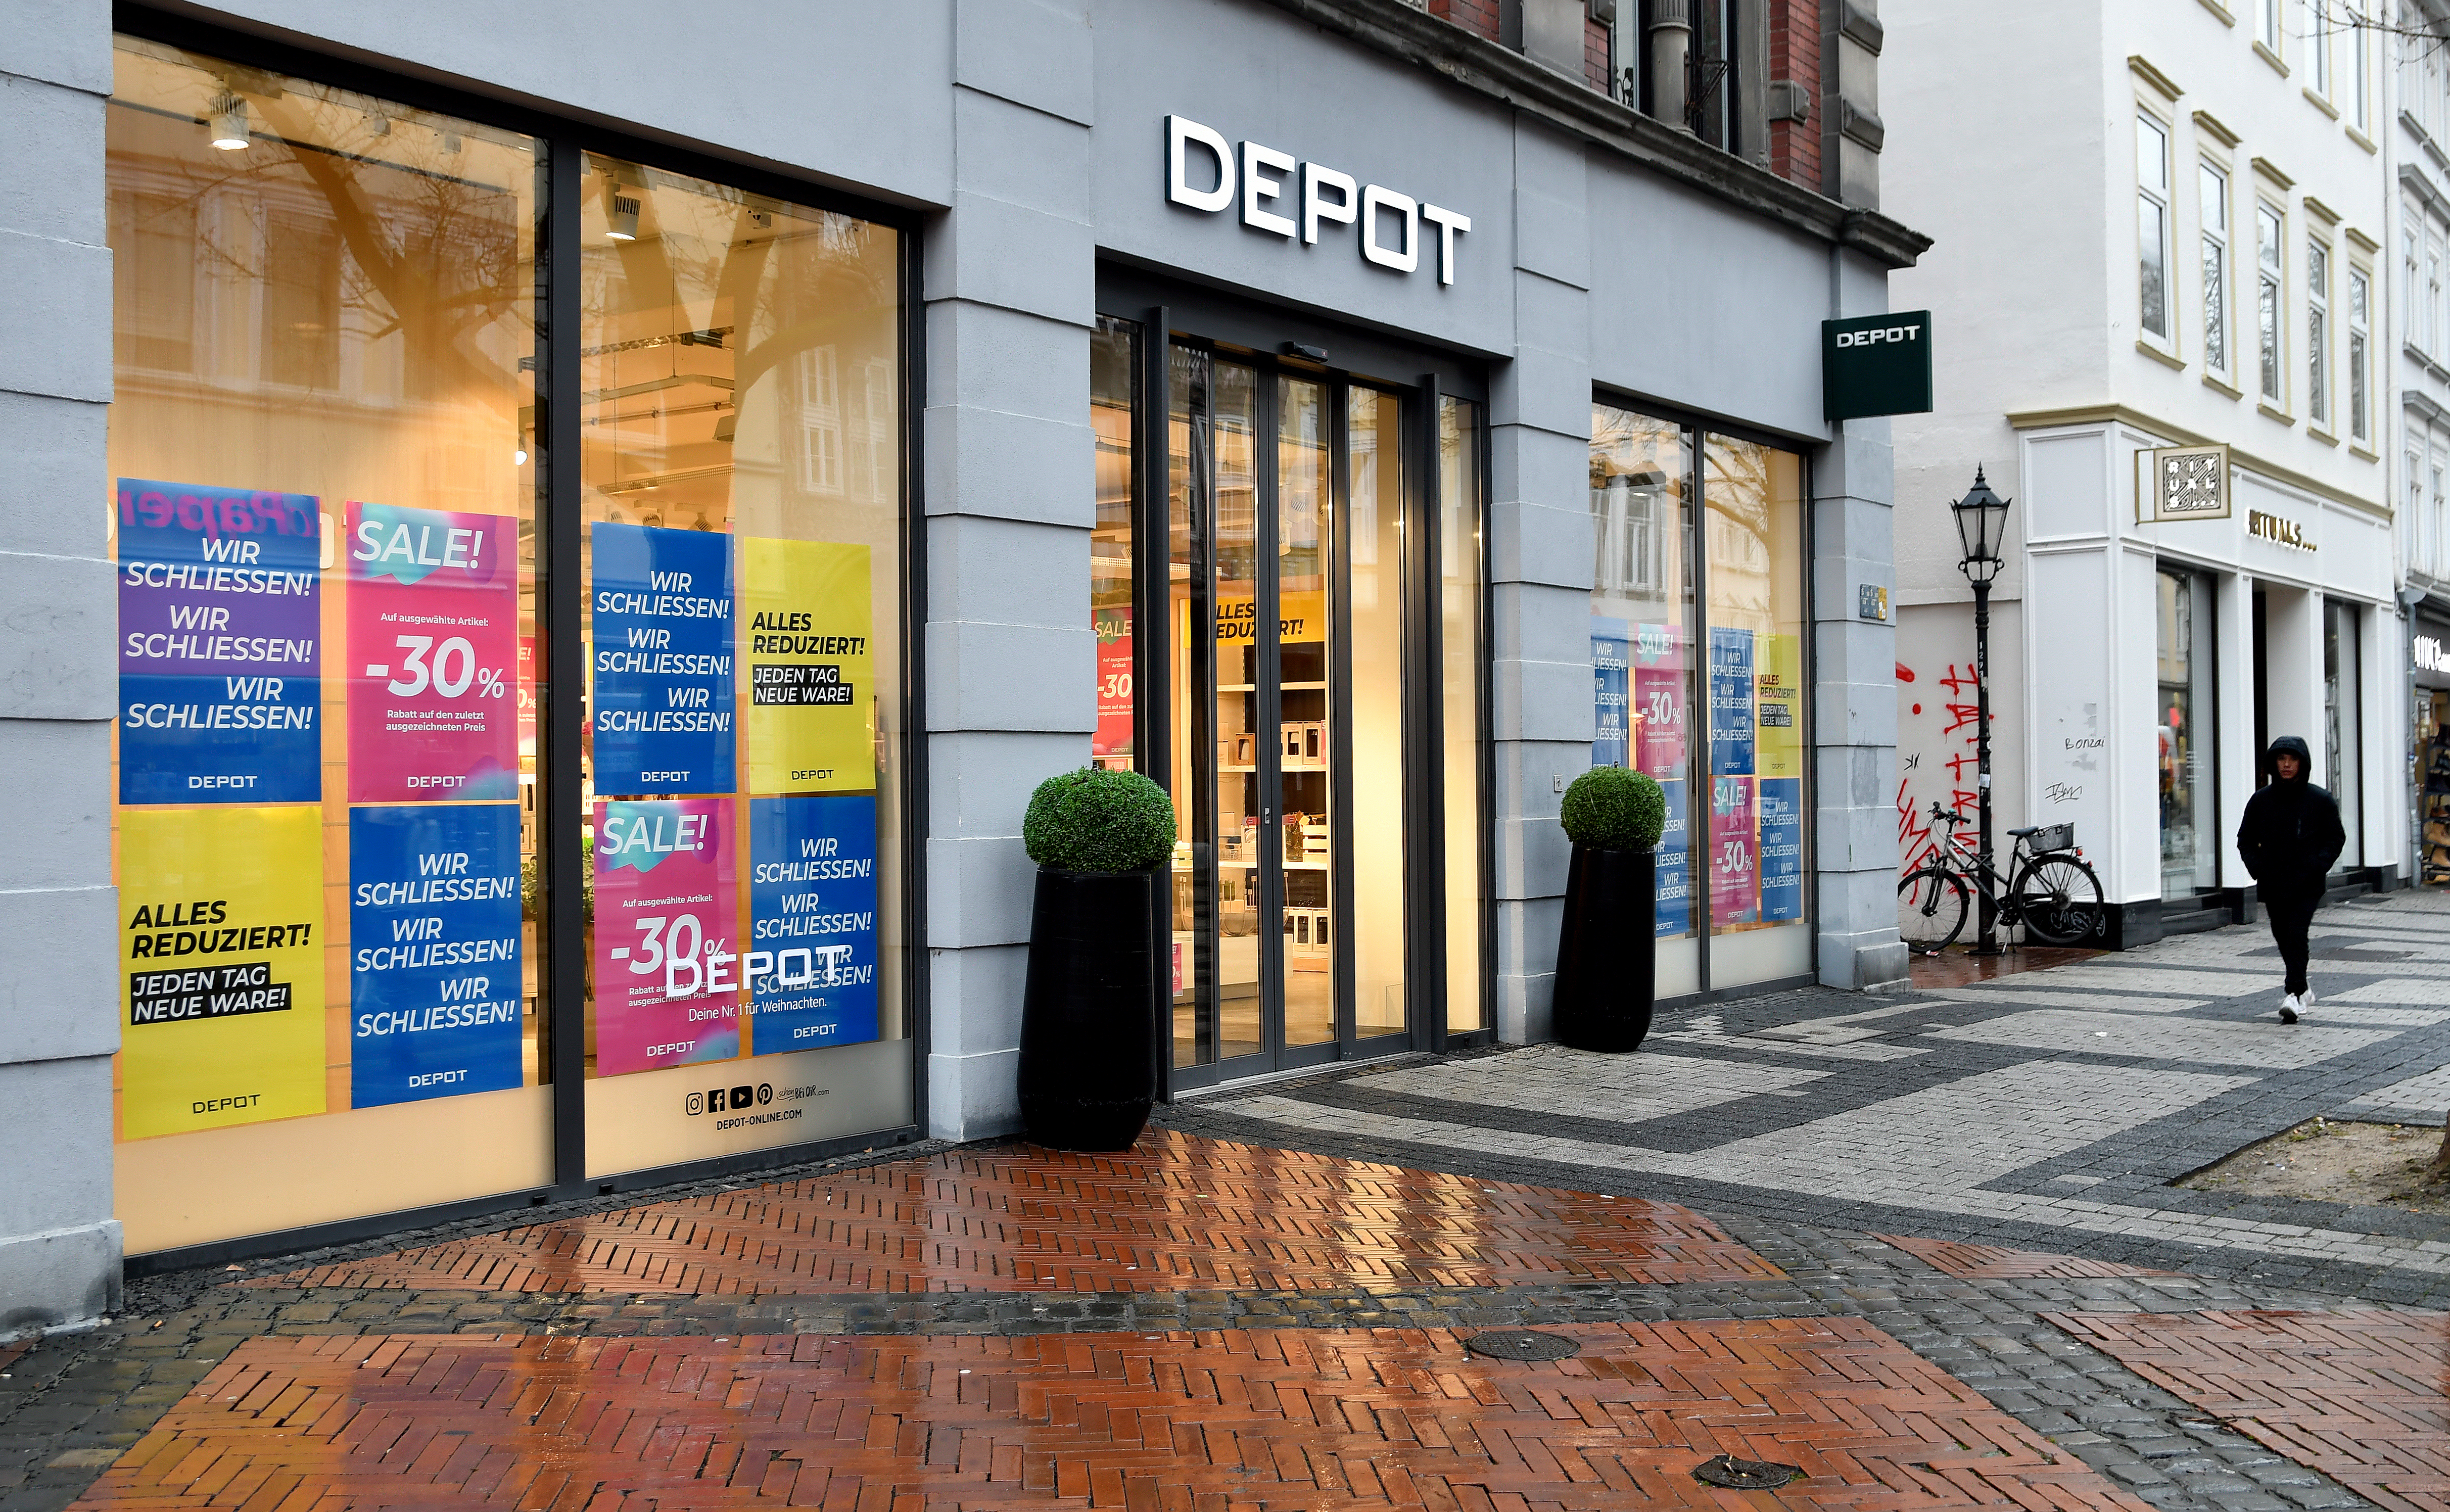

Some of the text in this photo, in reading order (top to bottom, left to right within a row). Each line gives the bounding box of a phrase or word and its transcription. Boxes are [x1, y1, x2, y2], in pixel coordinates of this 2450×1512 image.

[1164, 114, 1472, 286] DEPOT
[1836, 325, 1920, 348] DEPOT
[202, 538, 260, 564] WIR
[353, 521, 484, 569] SALE!
[125, 562, 312, 596] SCHLIESSEN!
[649, 571, 692, 593] WIR
[597, 592, 729, 619] SCHLIESSEN!
[1216, 602, 1254, 619] LLES
[170, 605, 230, 631] WIR
[381, 612, 489, 626] Auf ausgewählte Artikel:
[751, 611, 812, 632] ALLES
[1095, 620, 1132, 637] SALE
[627, 628, 671, 649] WIR
[752, 634, 865, 656] REDUZIERT!
[1637, 633, 1674, 656] SALE!
[125, 633, 313, 664] SCHLIESSEN!
[1596, 642, 1613, 655] WIR
[1727, 652, 1740, 664] WIR
[365, 635, 505, 699] -30%
[597, 651, 730, 676] SCHLIESSEN!
[1590, 657, 1627, 672] LIESSEN!
[1711, 665, 1752, 677] SCHLIESSEN!
[753, 668, 837, 684] JEDEN TAG
[1760, 674, 1779, 685] ALLES
[226, 677, 284, 701] WIR
[754, 687, 851, 703] NEUE WARE!
[1098, 674, 1132, 698] -30
[1721, 683, 1734, 695] WIR
[1760, 687, 1796, 699] REDUZIERT!
[667, 688, 710, 708] WIR
[1594, 691, 1627, 705] LIESSEN!
[1712, 697, 1753, 708] SCHLIESSEN!
[126, 704, 313, 730] SCHLIESSEN!
[387, 710, 485, 719] Rabatt auf den zuletzt
[1641, 691, 1681, 725] -30%
[1761, 705, 1787, 715] JEDEN TAG
[386, 722, 486, 732] ausgezeichneten Preis
[598, 710, 731, 732] SCHLIESSEN!
[1603, 713, 1619, 726] WIR
[1733, 716, 1746, 727] WIR
[1761, 716, 1791, 725] NEUE WARE!
[1595, 727, 1627, 741] IESSEN!
[1712, 729, 1753, 741] SCHLIESSEN!
[2065, 736, 2105, 749] Bonzai
[189, 776, 258, 788] DEPOT
[407, 776, 466, 788] DEPOT
[641, 771, 690, 782] DEPOT
[791, 770, 834, 780] DEPOT
[1713, 785, 1747, 807] SALE!
[1775, 801, 1788, 813] WIR
[1761, 814, 1799, 827] SCHLIESSEN!
[599, 814, 709, 855] SALE!
[1770, 832, 1782, 843] WIR
[800, 838, 838, 859] WIR
[1716, 840, 1753, 873] -30%
[1762, 844, 1799, 858] SCHLIESSEN!
[418, 853, 469, 876] WIR
[1656, 852, 1686, 867] LIESSEN!
[1780, 862, 1793, 874] WIR
[755, 859, 871, 884] SCHLIESSEN!
[1664, 872, 1679, 885] WIR
[1762, 874, 1800, 889] SCHLIESSEN!
[355, 877, 515, 907] SCHLIESSEN!
[622, 894, 713, 908] Auf ausgewählte Artikel:
[1656, 885, 1686, 902] LIESSEN!
[781, 893, 819, 914] WIR
[129, 901, 227, 929] ALLES
[392, 917, 443, 941] WIR
[756, 912, 872, 939] SCHLIESSEN!
[1656, 921, 1673, 930] DEPOT
[131, 923, 312, 959] REDUZIERT!
[356, 939, 515, 972] SCHLIESSEN!
[666, 944, 846, 997] DEPOT
[133, 966, 266, 997] JEDEN TAG
[440, 977, 490, 1002] WIR
[629, 986, 654, 996] Rabatt
[134, 987, 287, 1021] NEUE WARE!
[693, 990, 712, 1000] Preis
[356, 1001, 515, 1037] SCHLIESSEN!
[689, 997, 827, 1022] Deine Nr. 1 für Weihnachten.
[793, 1023, 837, 1038] DEPOT
[646, 1040, 695, 1057] DEPOT
[409, 1069, 468, 1088] DEPOT
[193, 1094, 261, 1114] DEPOT
[717, 1108, 803, 1131] DEPOT-ONLINE.COM
